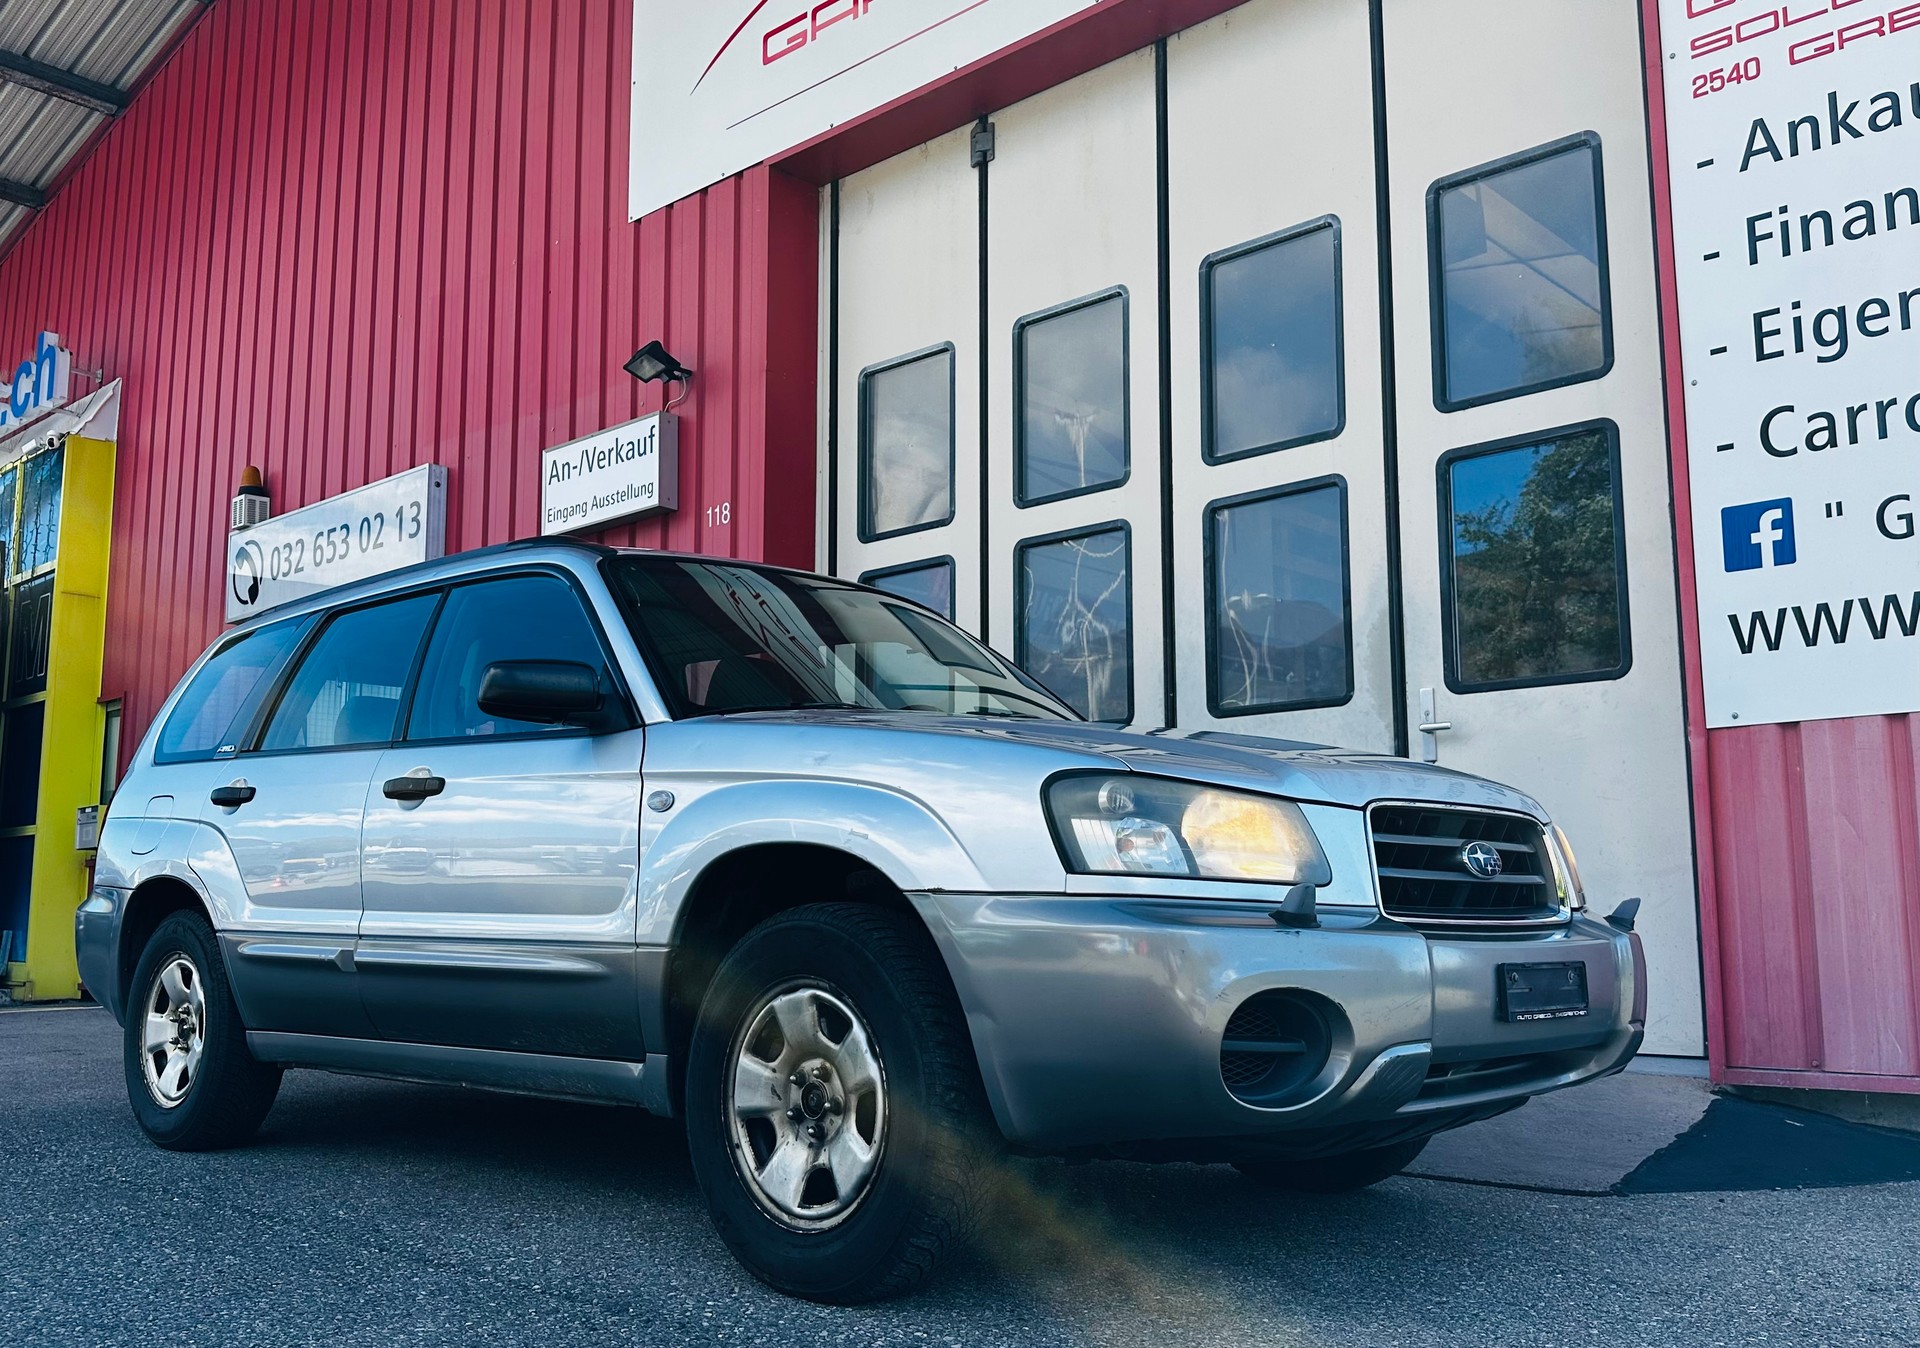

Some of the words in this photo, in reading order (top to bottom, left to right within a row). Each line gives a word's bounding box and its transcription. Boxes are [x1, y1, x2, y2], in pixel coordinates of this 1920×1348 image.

[1692, 57, 1761, 98] 2540
[1746, 187, 1920, 266] Finan
[548, 425, 656, 486] An-/Verkauf
[547, 500, 588, 524] Eingang
[591, 481, 654, 511] Ausstellung
[706, 502, 731, 528] 118
[1875, 494, 1915, 540] G
[270, 538, 304, 581] 032
[313, 523, 350, 567] 653
[359, 512, 385, 553] 02
[395, 500, 422, 543] 13
